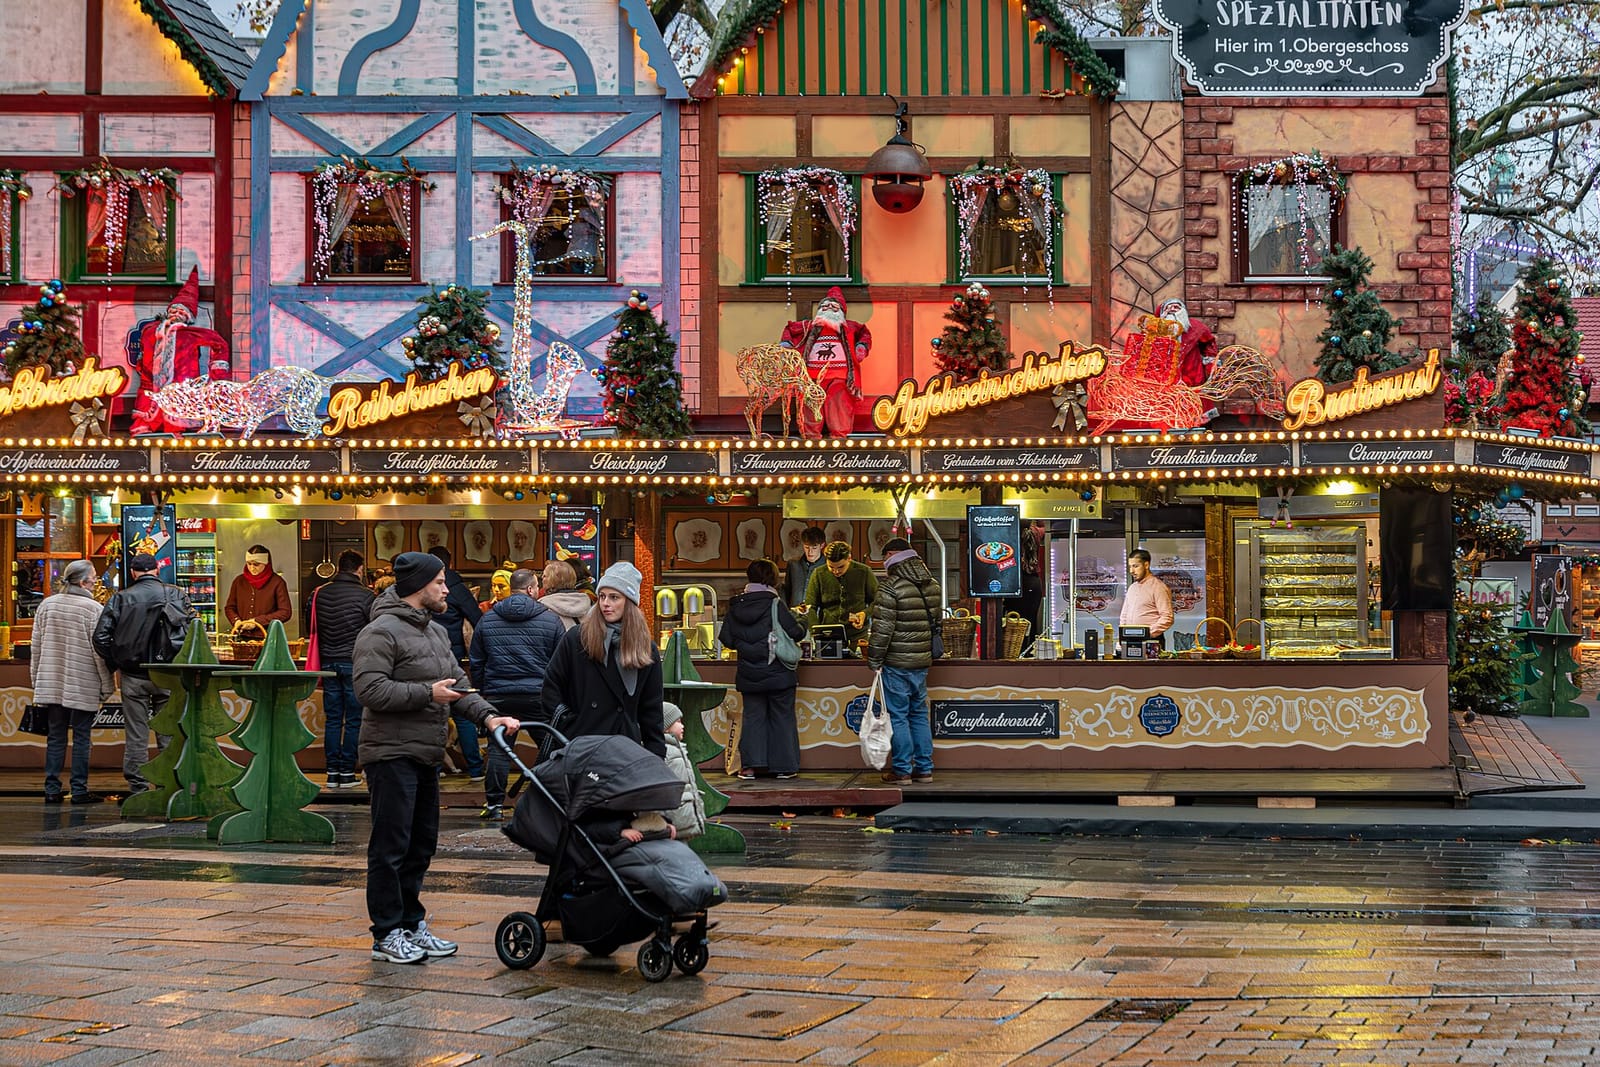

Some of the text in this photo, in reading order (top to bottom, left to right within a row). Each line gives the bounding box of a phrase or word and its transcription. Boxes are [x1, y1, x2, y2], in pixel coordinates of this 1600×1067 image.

[1216, 0, 1402, 28] SPEZIALITÄTEN
[1215, 37, 1410, 56] Hier im 1.Obergeschoss
[322, 362, 495, 436] Reibekuchen
[873, 344, 1106, 437] Apfelweinschinken
[1283, 348, 1441, 431] Bratwurst
[0, 451, 121, 473] Apfelweinschinken
[191, 451, 311, 470] Handkäseknacker
[383, 451, 499, 474] Kartoffellöckscher
[589, 452, 668, 475] Fleischspieß
[740, 452, 902, 473] Hausgemachte Reibekuchen
[1015, 452, 1083, 469] Holzkohlegrill
[1147, 446, 1258, 466] Handkäsknacker
[1348, 443, 1434, 465] Champignons
[1498, 447, 1571, 471] Kartoffelworscht
[944, 710, 1047, 732] Currybratworscht
